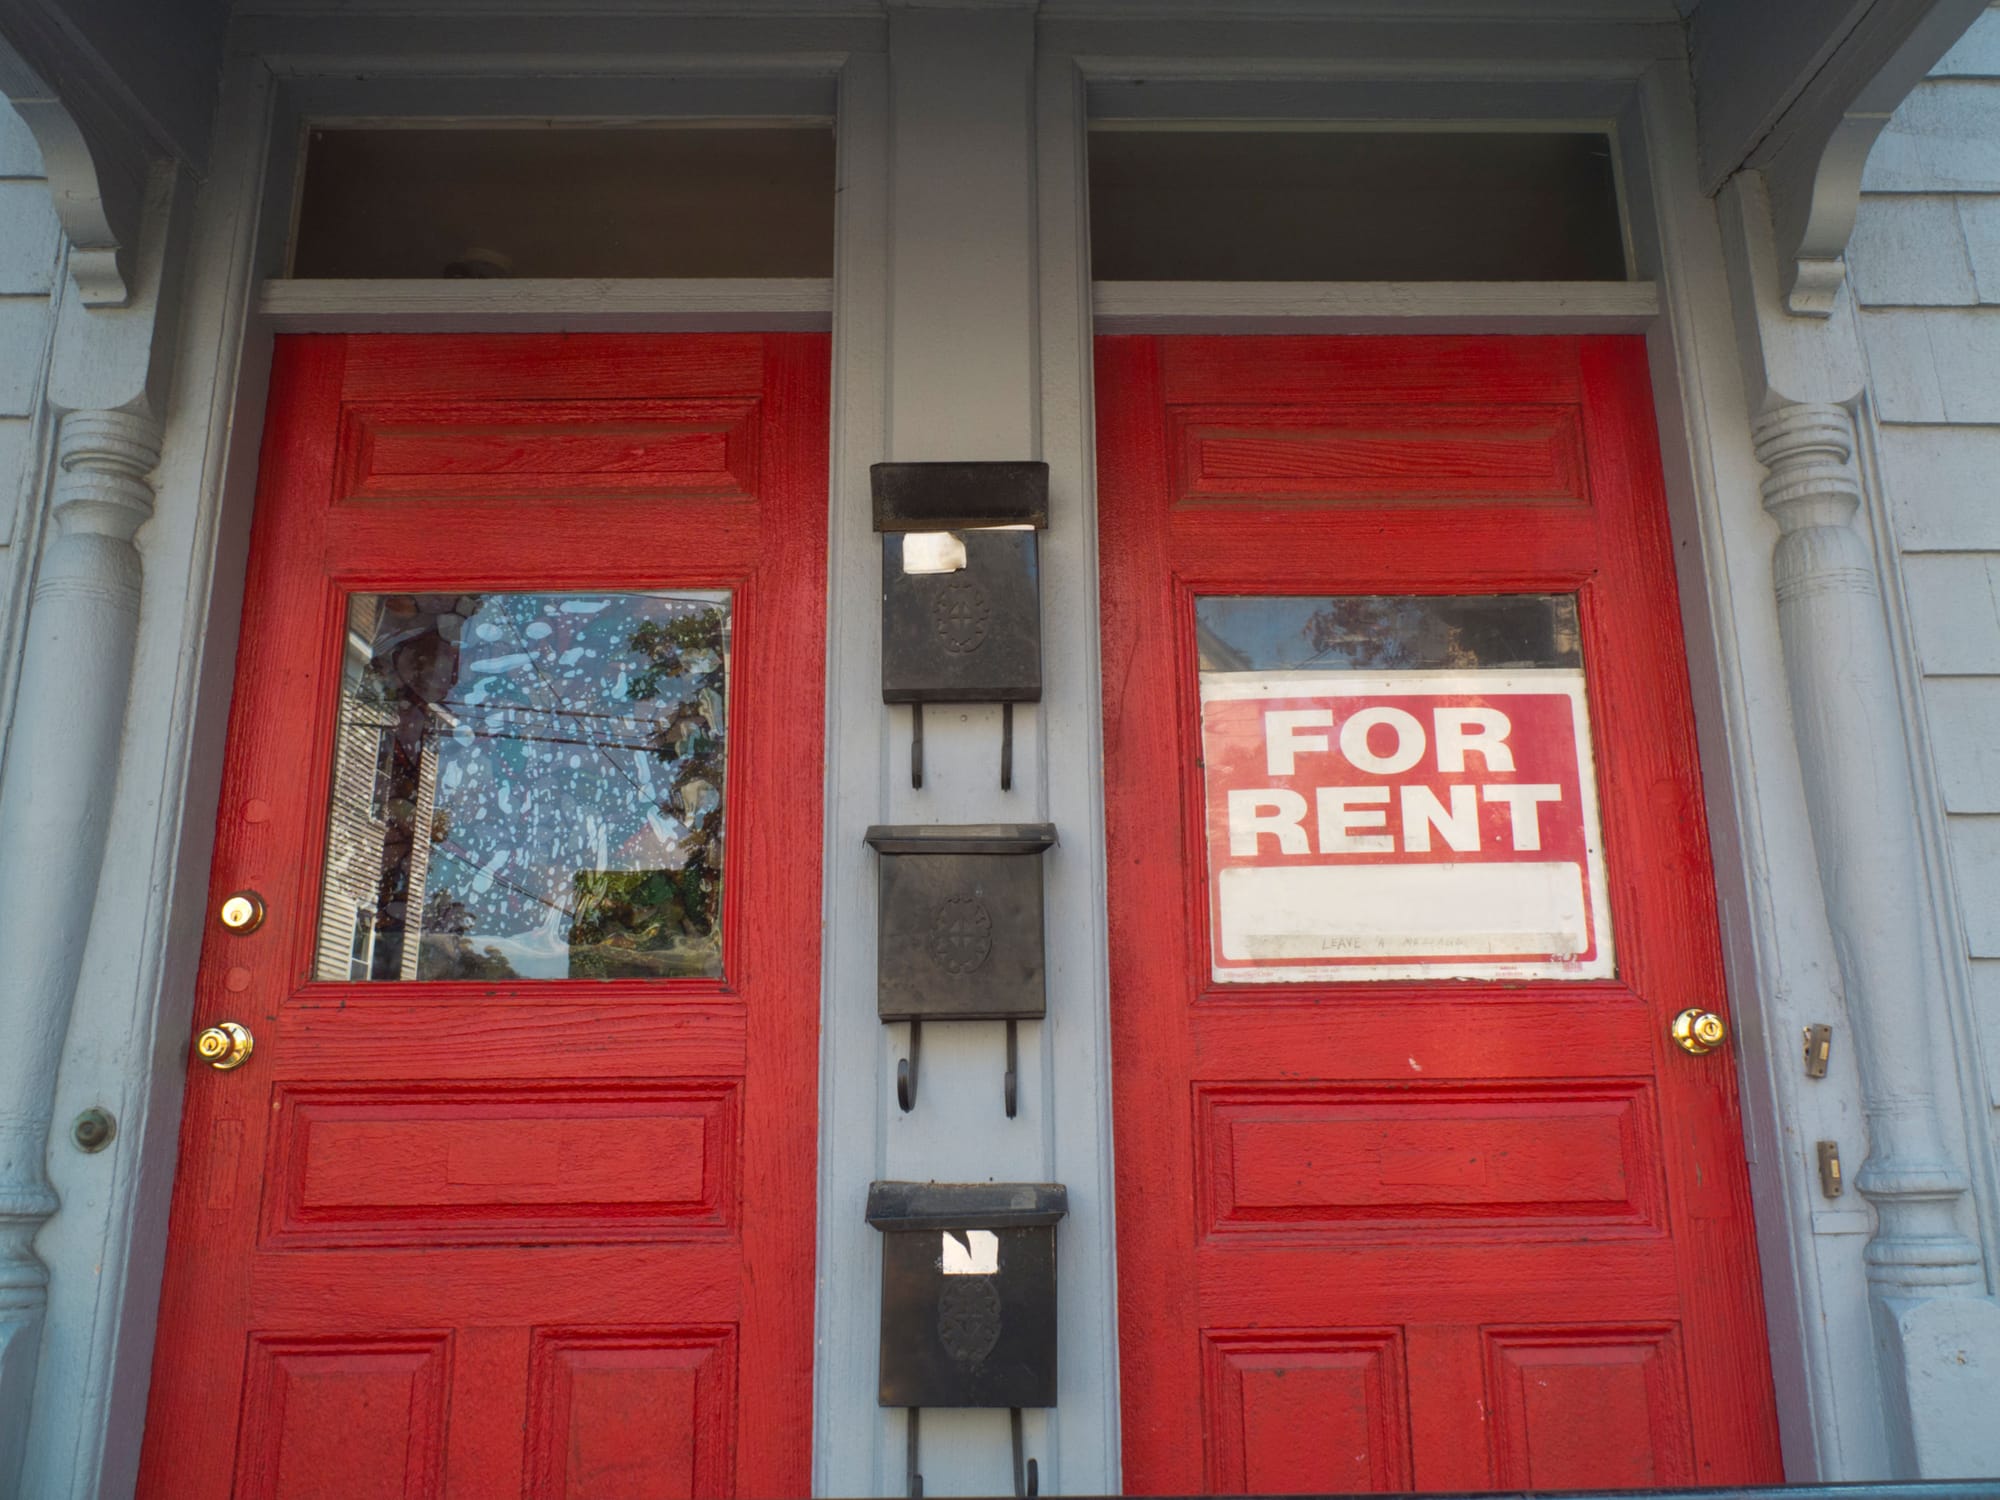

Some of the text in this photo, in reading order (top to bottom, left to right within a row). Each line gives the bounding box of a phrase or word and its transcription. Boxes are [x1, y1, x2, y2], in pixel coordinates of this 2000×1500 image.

[1264, 706, 1516, 776] FOR
[1227, 784, 1562, 857] RENT
[1321, 935, 1361, 950] LEAVE
